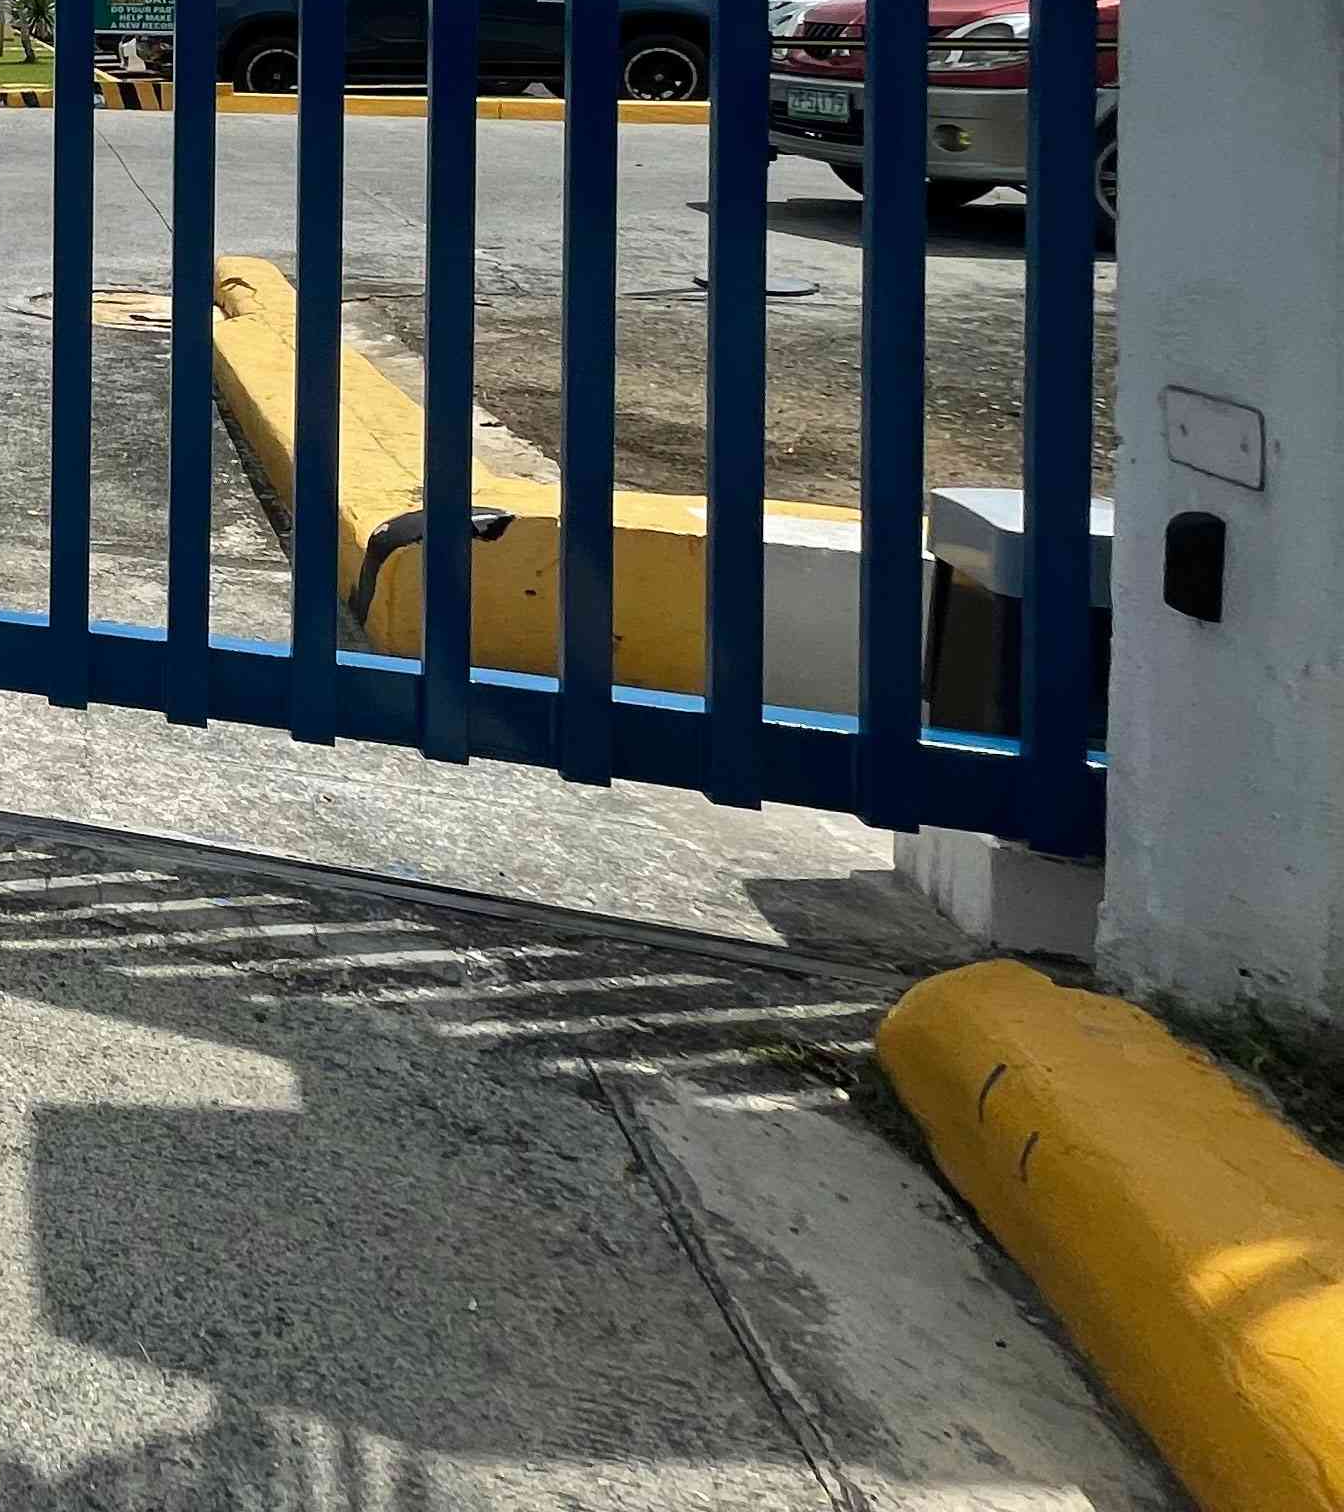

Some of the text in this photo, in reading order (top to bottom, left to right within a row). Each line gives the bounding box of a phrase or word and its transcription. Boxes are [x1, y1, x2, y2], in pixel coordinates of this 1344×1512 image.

[111, 6, 125, 14] DO
[126, 6, 152, 14] YOUR
[119, 14, 144, 22] HELP
[110, 22, 175, 30] A NEW RECOR
